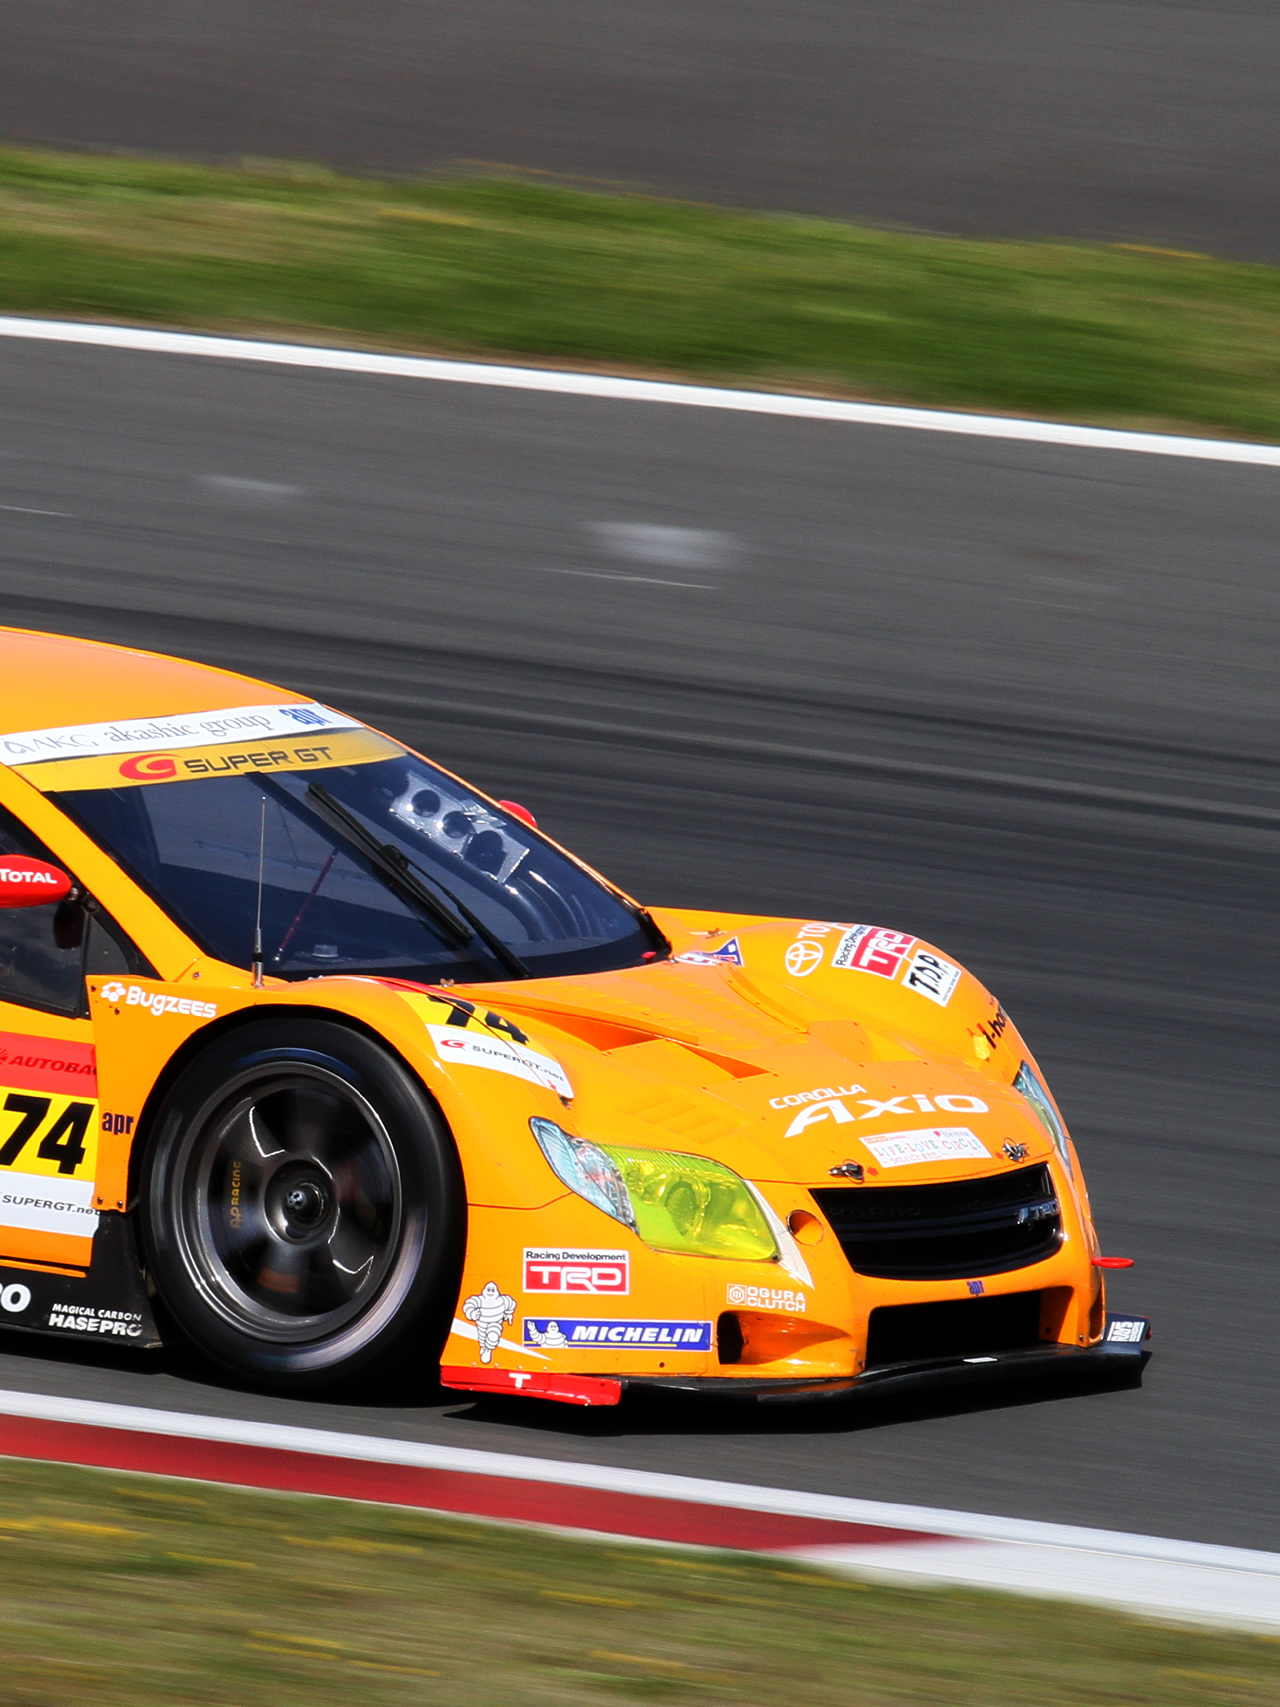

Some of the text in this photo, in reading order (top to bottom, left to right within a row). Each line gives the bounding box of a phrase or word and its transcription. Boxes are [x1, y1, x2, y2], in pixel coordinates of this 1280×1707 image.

[104, 718, 200, 742] akashic
[200, 713, 276, 737] group
[183, 750, 293, 774] SUPER
[293, 746, 336, 763] GT
[859, 929, 908, 967] TRD
[426, 994, 531, 1046] 74
[768, 1084, 868, 1110] COROLLA
[102, 1111, 135, 1136] apr
[525, 1250, 627, 1262] Racing Development
[529, 1266, 623, 1292] TRD
[746, 1296, 806, 1314] CLUTCH
[747, 1285, 806, 1303] OGURA
[48, 1312, 144, 1338] HASEPRO
[52, 1302, 142, 1323] MAGICAL CARBON
[571, 1324, 704, 1344] MICHELIN
[508, 1372, 532, 1389] T
